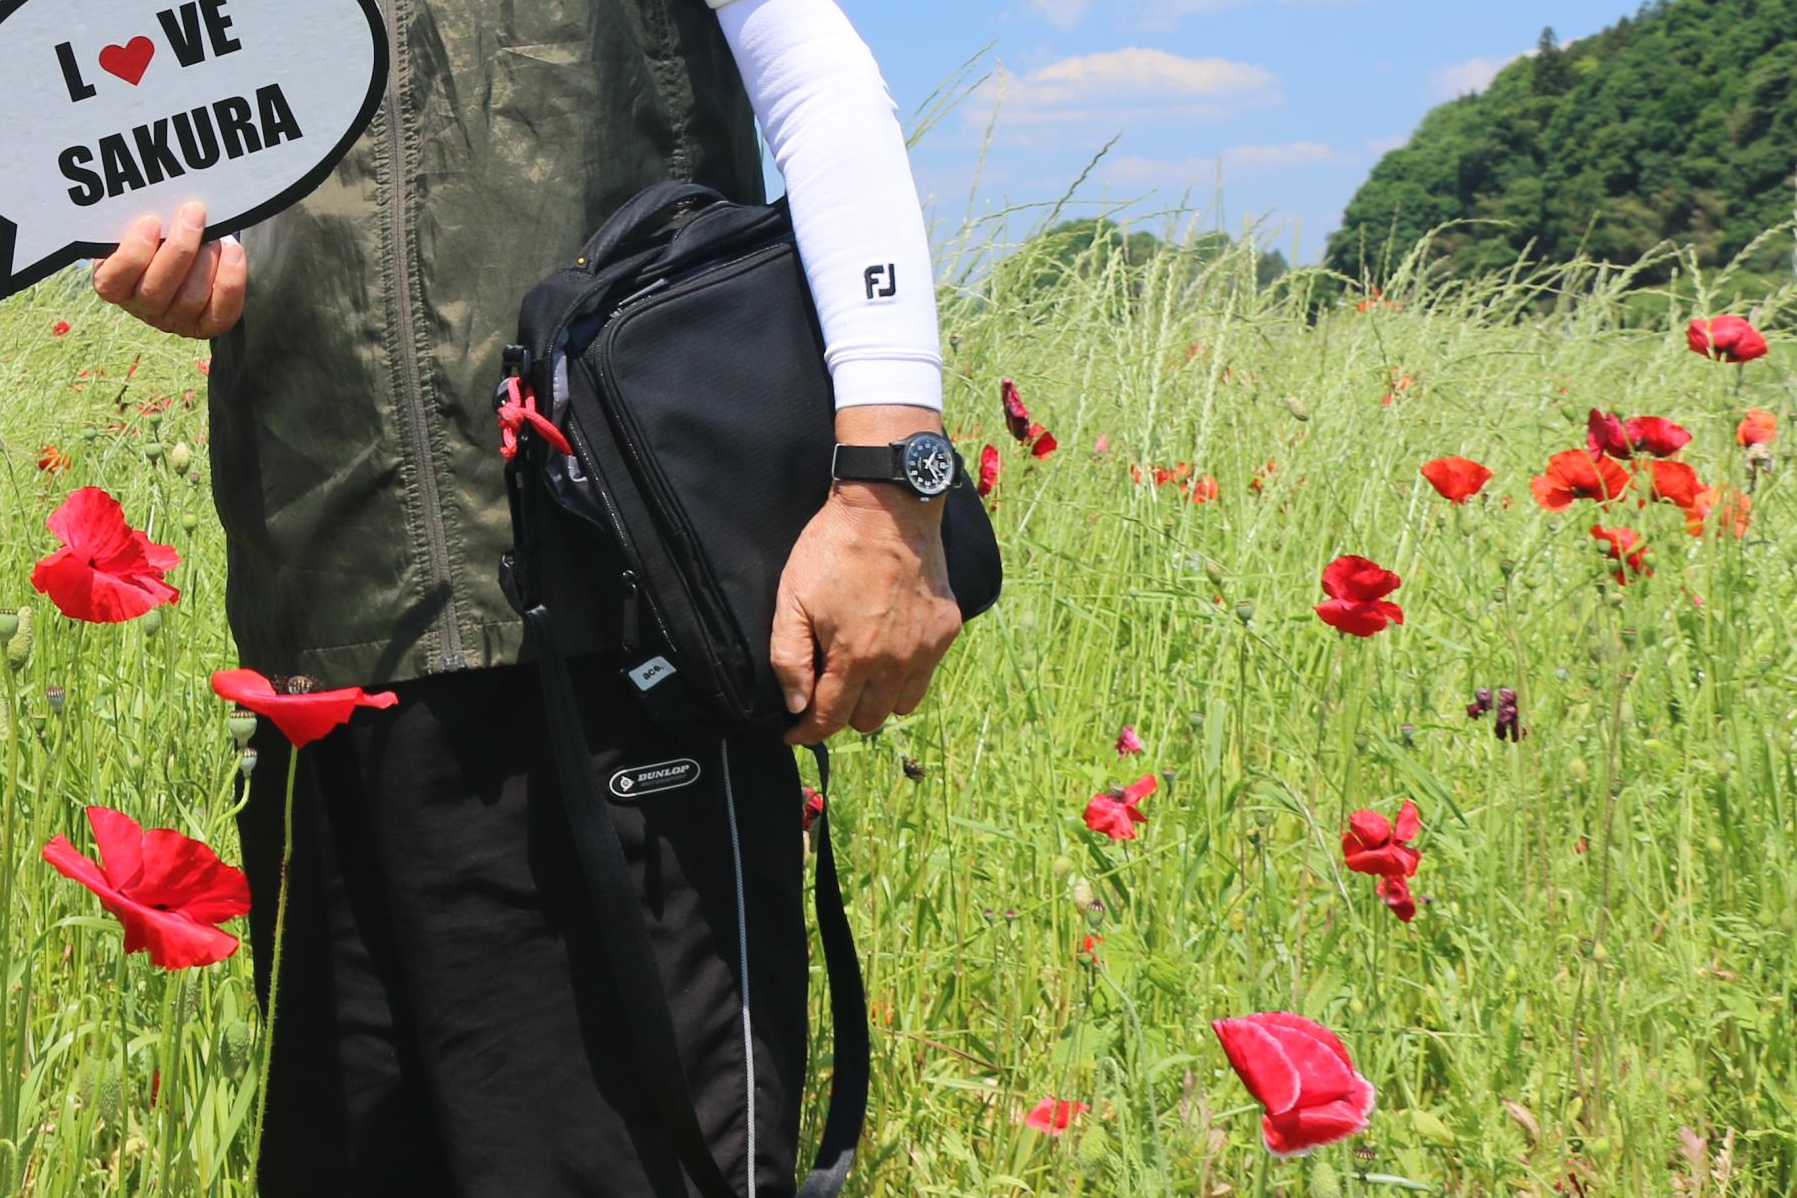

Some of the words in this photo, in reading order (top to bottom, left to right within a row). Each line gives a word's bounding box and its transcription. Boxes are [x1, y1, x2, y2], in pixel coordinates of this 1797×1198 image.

[58, 83, 303, 206] SAKURA
[864, 263, 896, 299] FJ
[637, 765, 690, 781] DUNLOP
